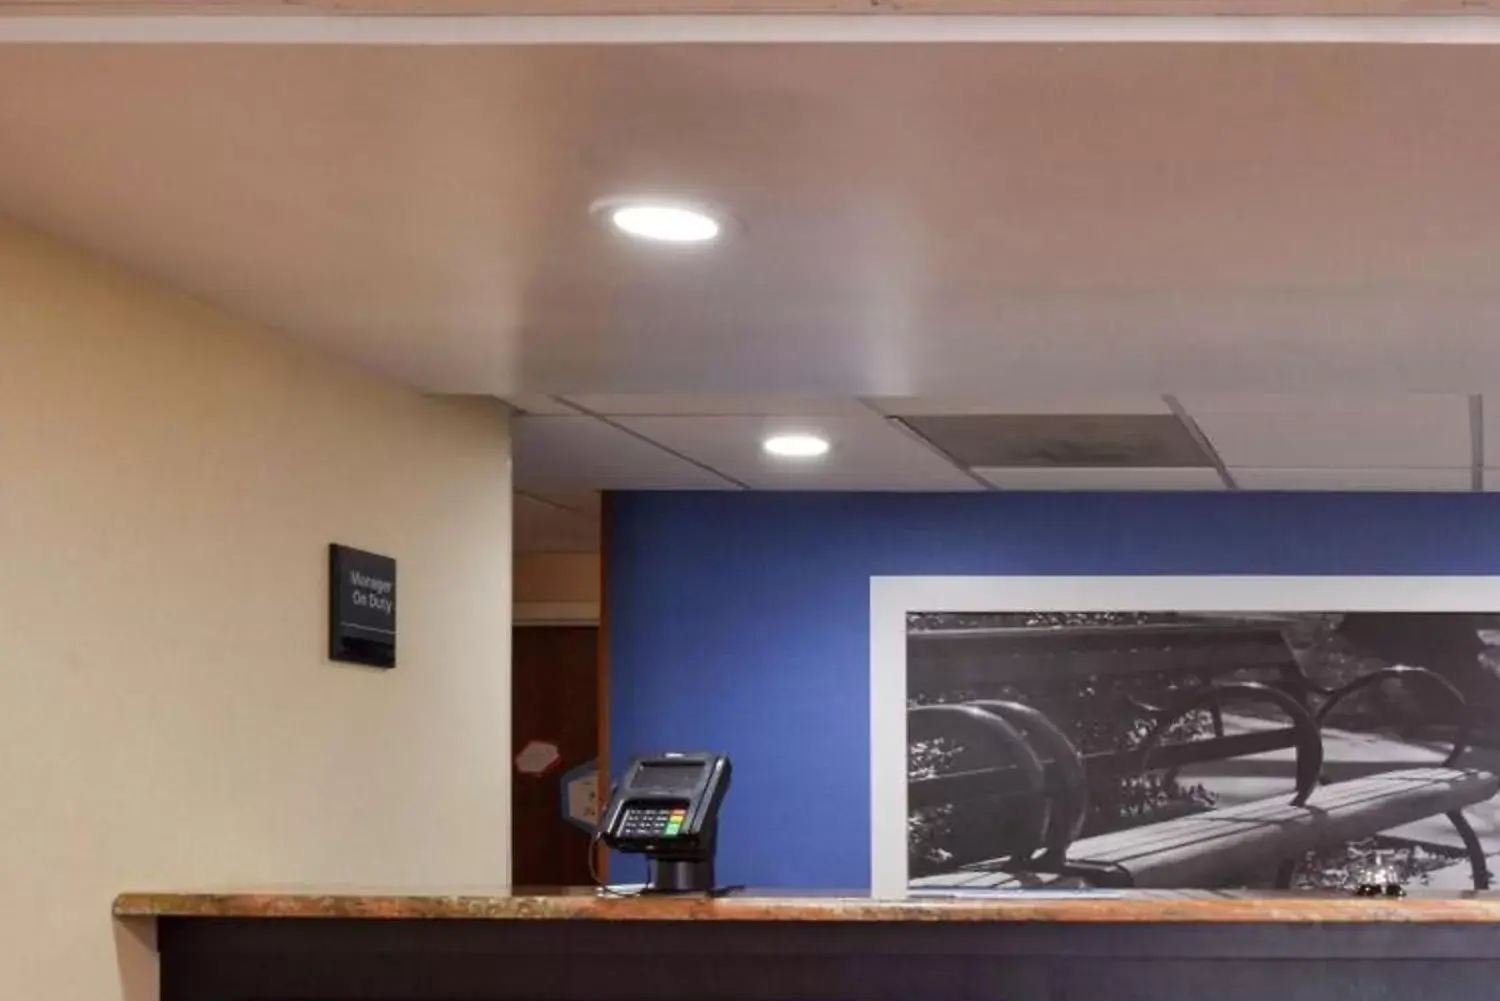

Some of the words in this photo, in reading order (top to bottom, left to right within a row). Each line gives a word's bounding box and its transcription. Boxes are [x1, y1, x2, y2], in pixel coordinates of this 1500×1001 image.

[350, 569, 392, 594] Manager
[352, 590, 367, 606] On
[369, 592, 392, 615] Duty
